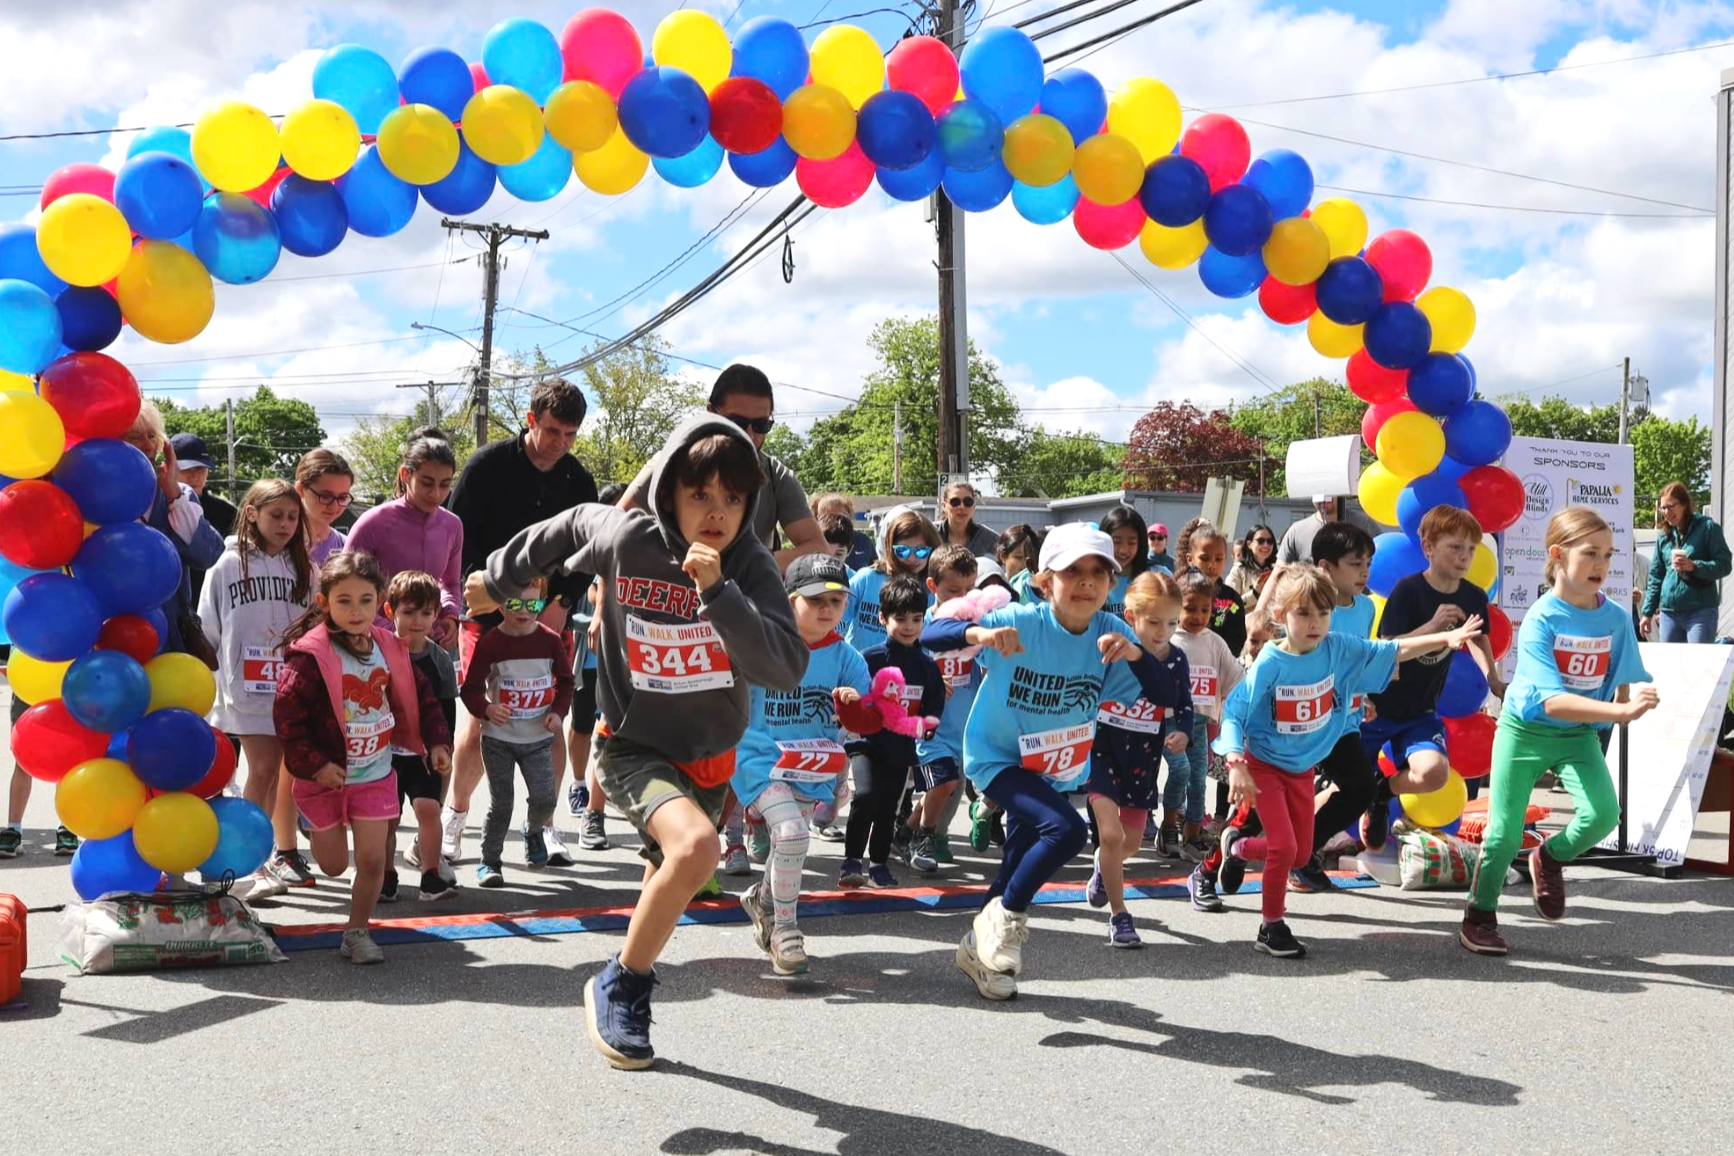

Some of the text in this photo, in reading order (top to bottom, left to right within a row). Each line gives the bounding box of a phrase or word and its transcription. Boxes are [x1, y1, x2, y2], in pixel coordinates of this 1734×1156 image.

[1529, 446, 1558, 454] THANK
[1533, 457, 1606, 471] SPONSORS
[1580, 484, 1612, 497] PAPALIA
[1525, 503, 1548, 512] Blinds
[1526, 495, 1549, 505] Design
[1572, 495, 1619, 505] HOME SERVICES
[639, 643, 713, 675] 344
[943, 658, 963, 676] 81
[1567, 654, 1598, 676] 60
[1013, 665, 1065, 691] UNITED
[1190, 678, 1210, 695] 75
[508, 690, 545, 708] 377
[1008, 681, 1062, 708] WE RUN
[777, 702, 801, 717] RUN
[1006, 698, 1071, 716] for mental health
[1296, 697, 1322, 721] 61
[347, 735, 379, 756] 38
[795, 751, 830, 771] 77
[1042, 746, 1075, 774] 78
[1657, 848, 1680, 863] TOP
